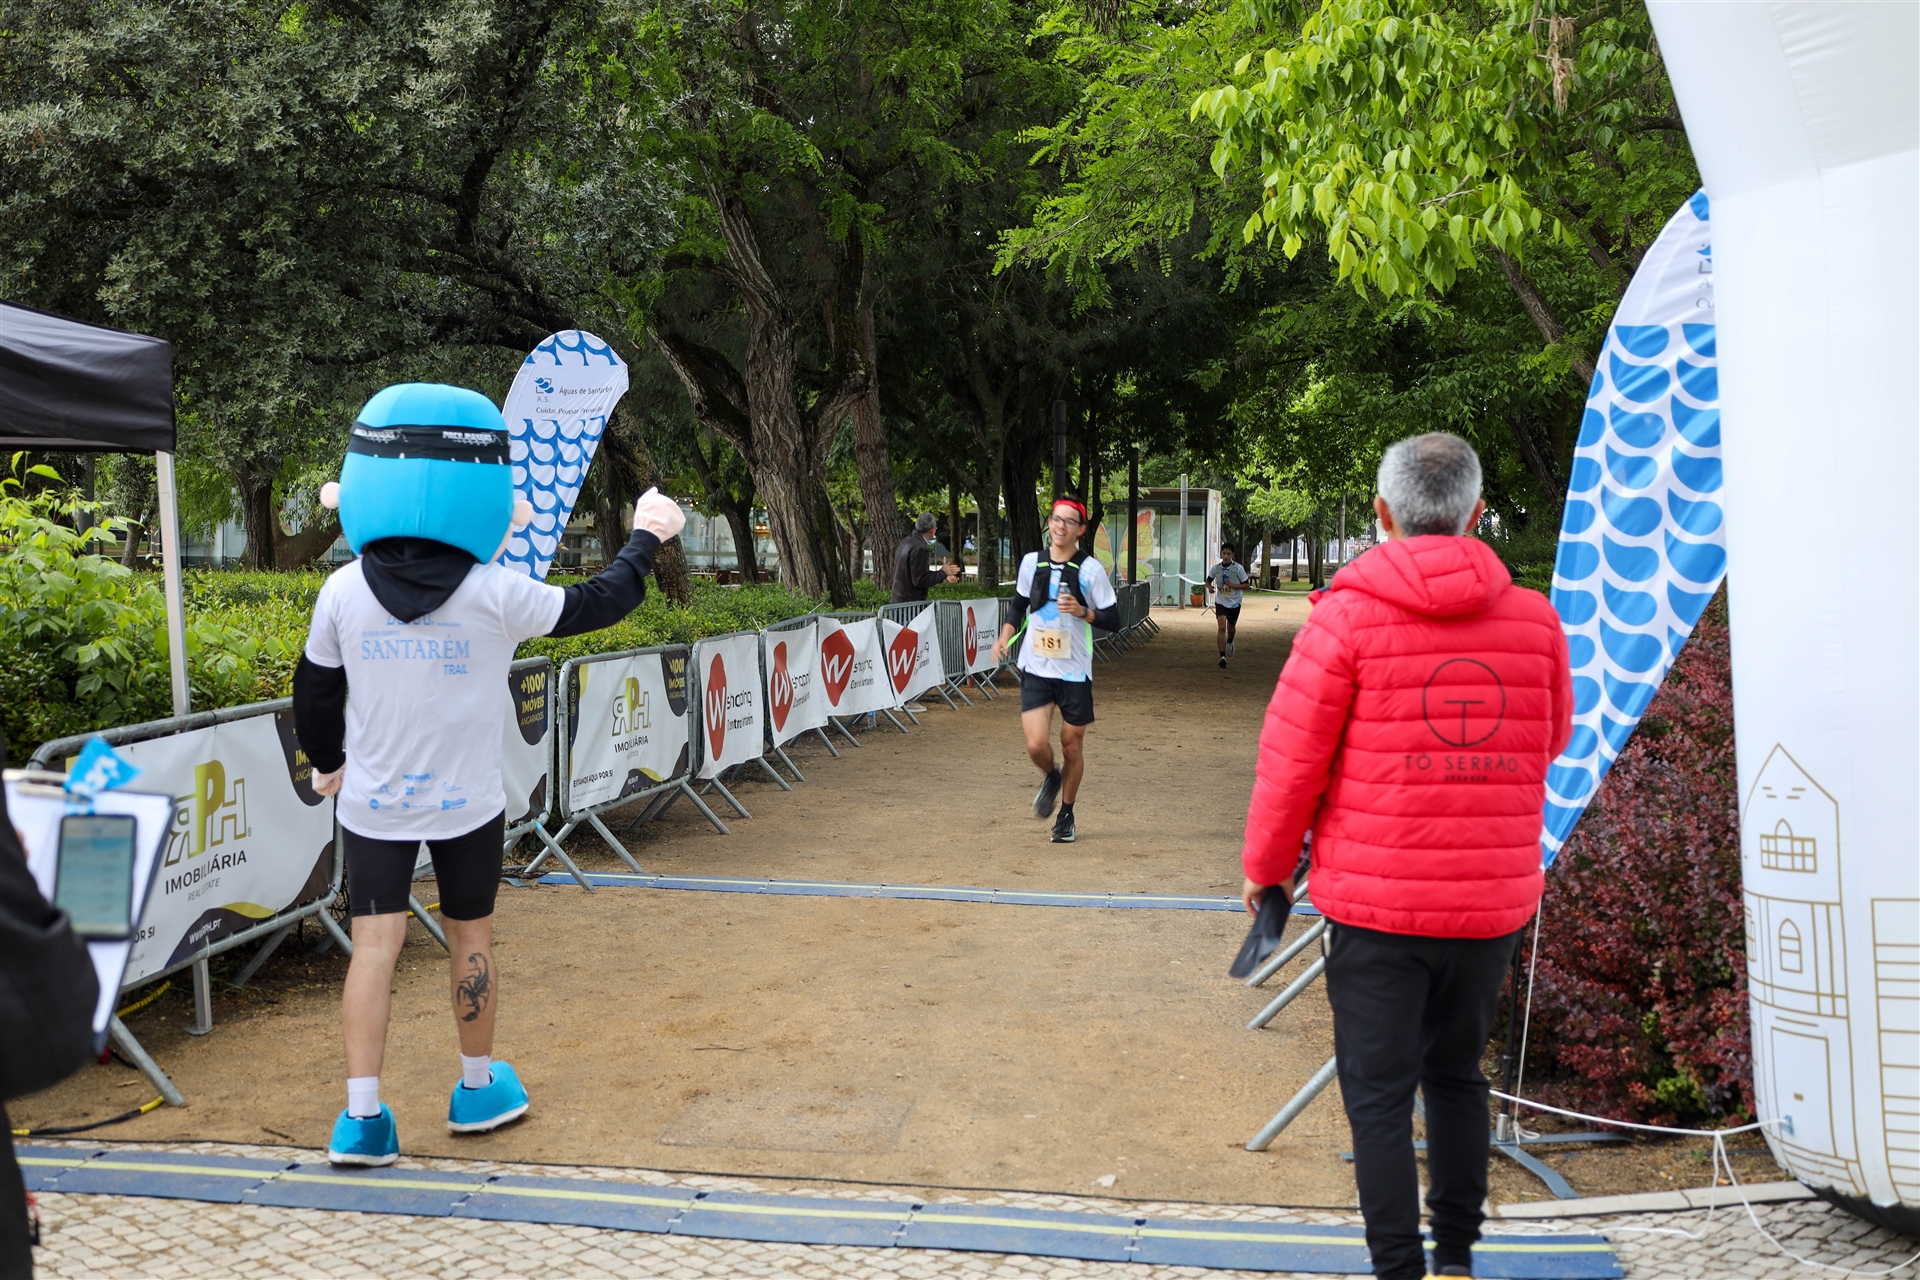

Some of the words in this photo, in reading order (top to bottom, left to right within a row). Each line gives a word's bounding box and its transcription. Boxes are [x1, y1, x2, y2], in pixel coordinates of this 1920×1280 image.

[559, 386, 578, 396] Águas
[361, 634, 470, 660] SANTARÉM
[1041, 636, 1061, 649] 181
[443, 664, 468, 675] TRAIL
[520, 671, 546, 695] +1000
[521, 694, 545, 714] IMÓVEIS
[1404, 752, 1432, 770] TÓ
[1444, 753, 1519, 773] SERRÃO
[165, 850, 247, 895] IMOBILIÁRIA
[147, 926, 156, 939] SI
